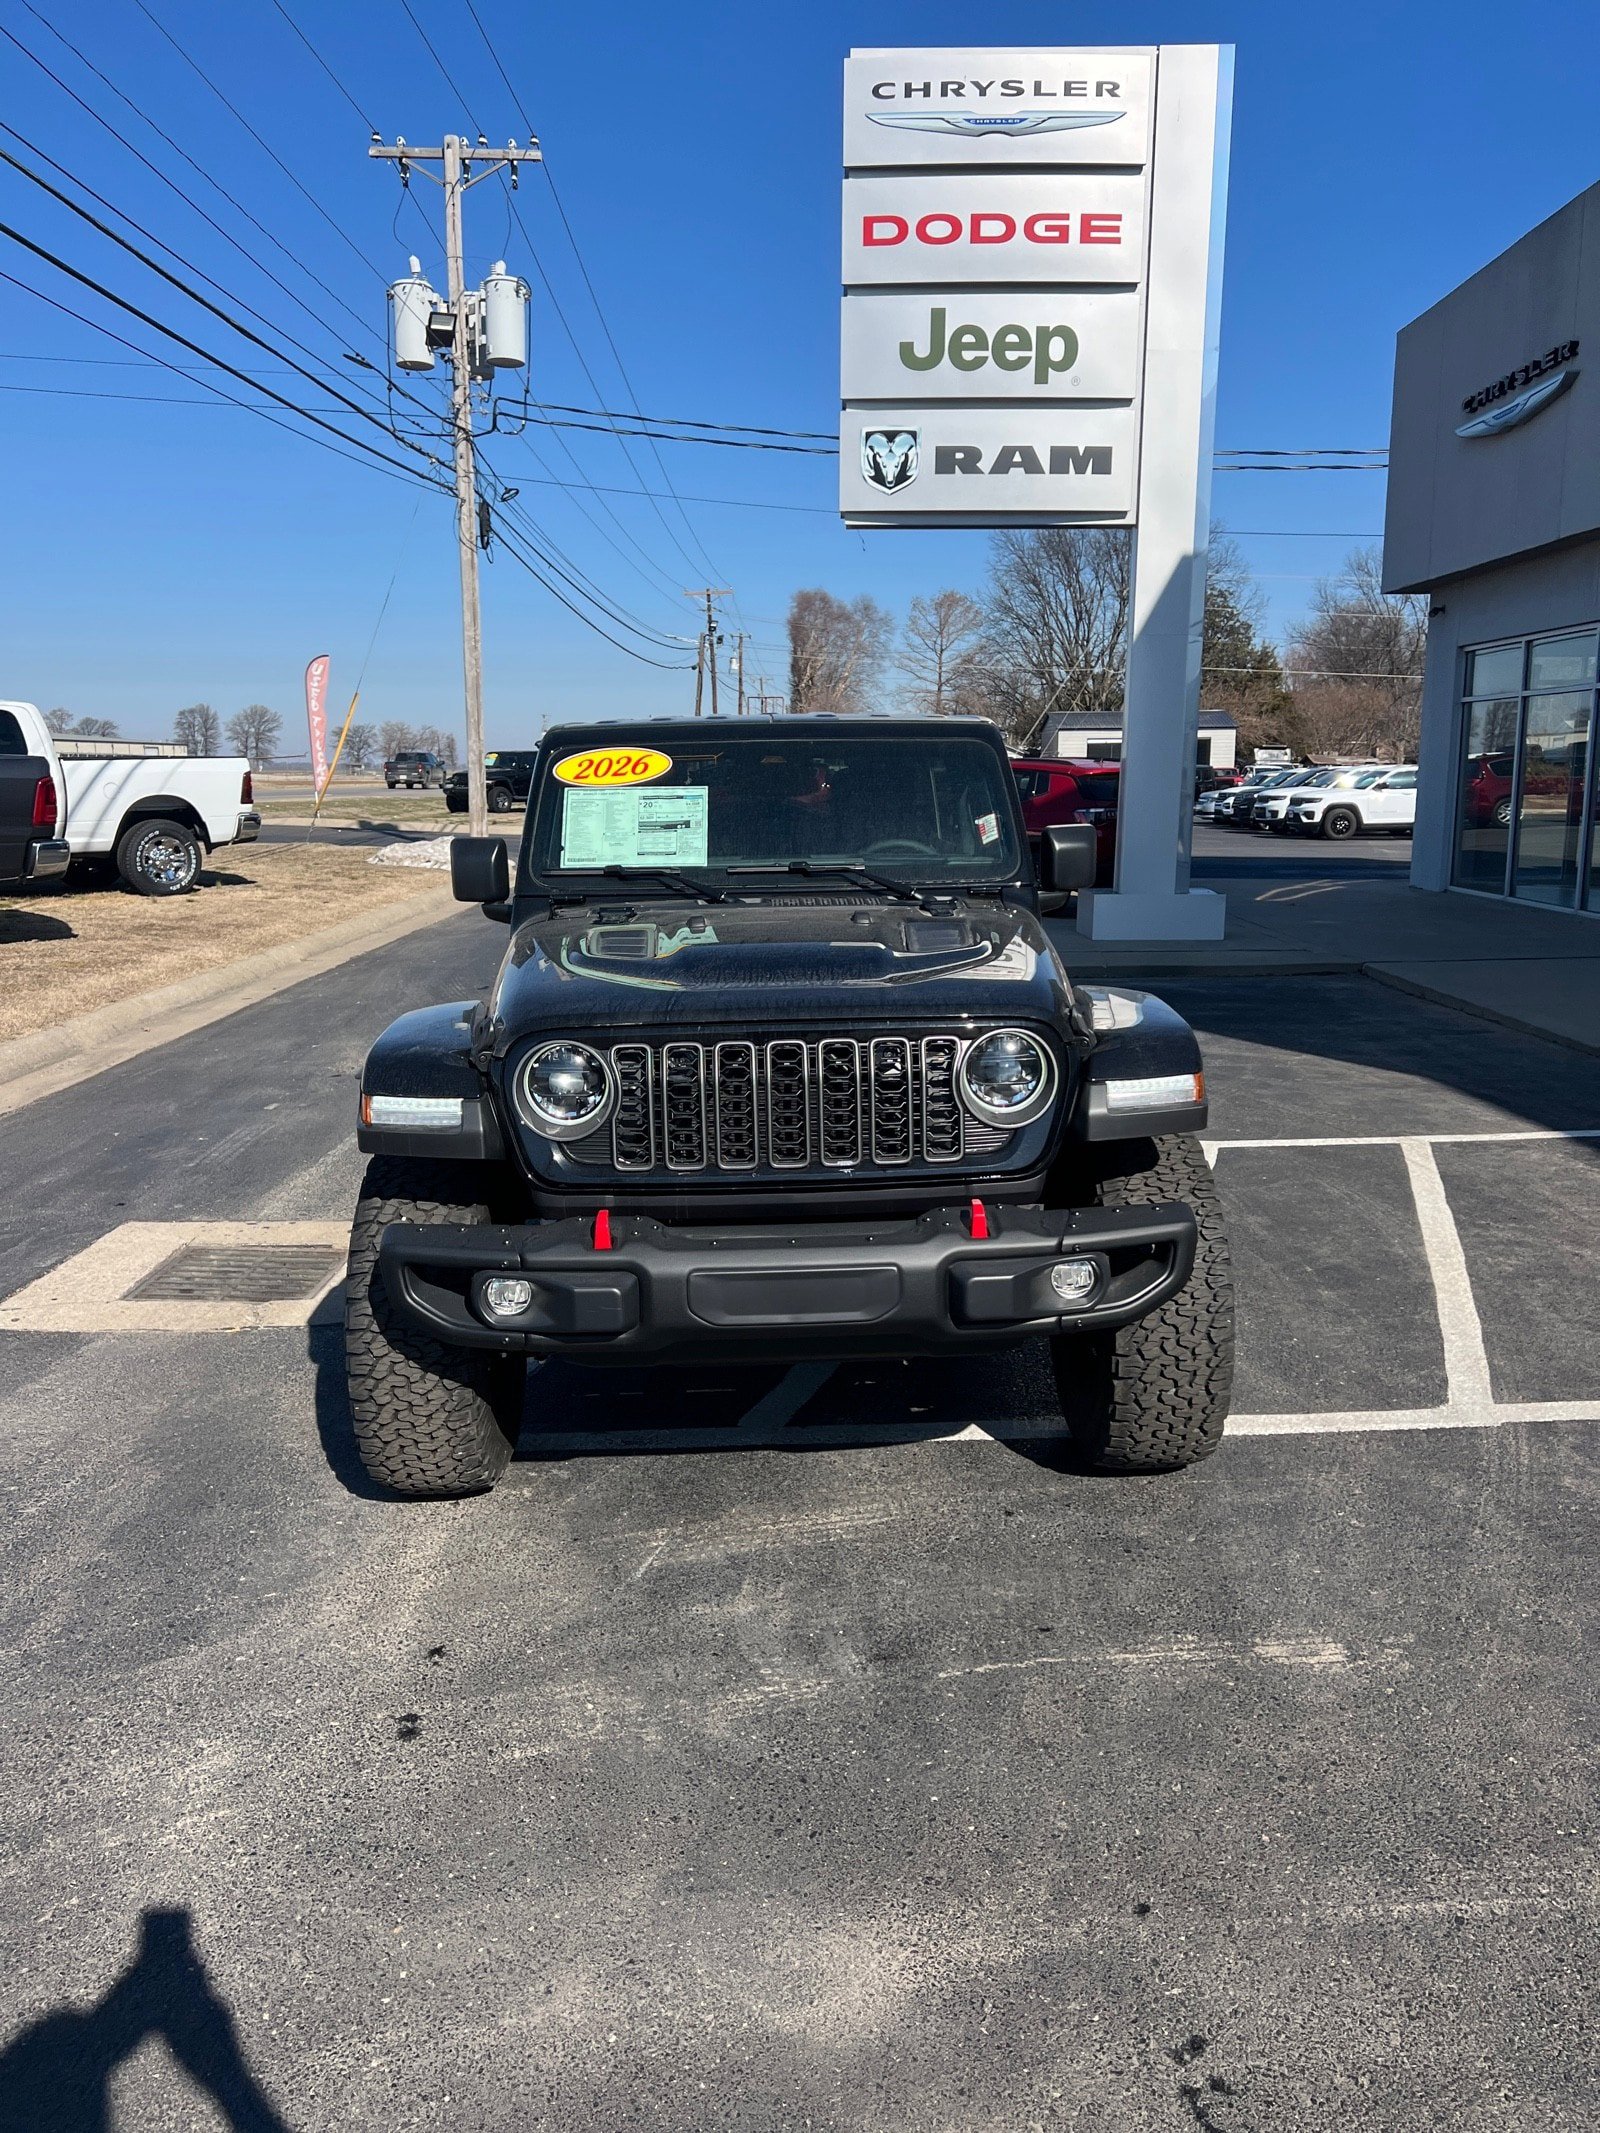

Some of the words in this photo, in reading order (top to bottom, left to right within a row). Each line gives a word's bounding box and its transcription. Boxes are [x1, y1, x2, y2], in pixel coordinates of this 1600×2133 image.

[871, 79, 1121, 100] CHRYSLER
[862, 213, 1122, 247] DODGE
[899, 307, 1079, 385] Jeep
[1462, 340, 1580, 413] CHRYSLER
[934, 445, 1113, 475] RAM
[573, 754, 653, 780] 2026
